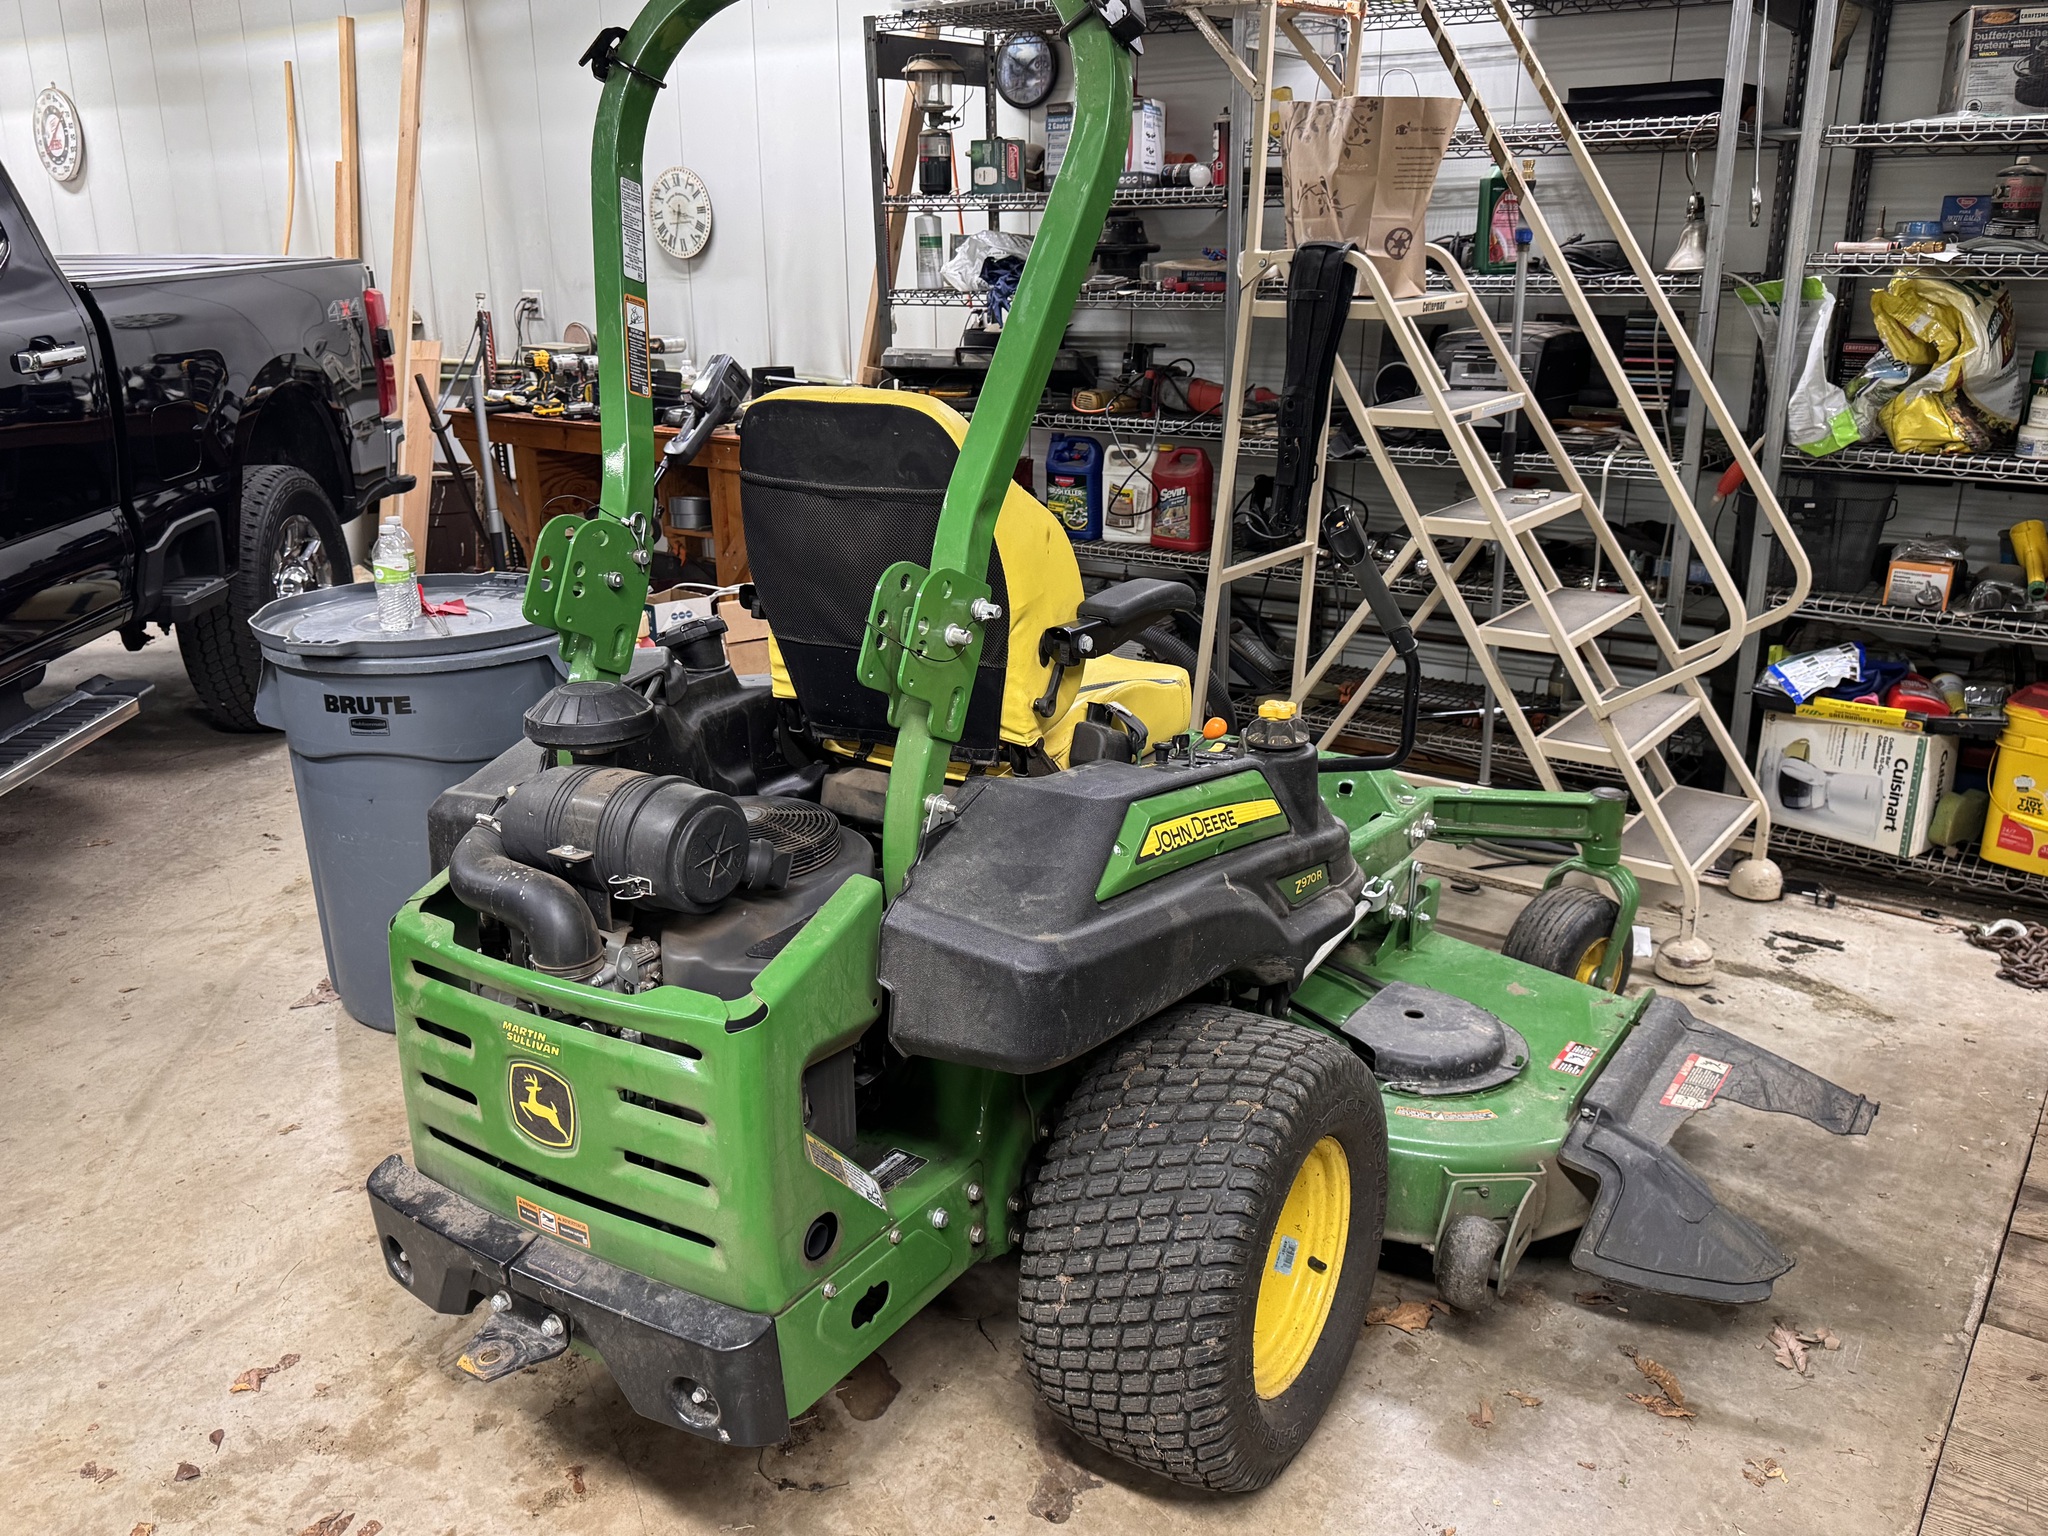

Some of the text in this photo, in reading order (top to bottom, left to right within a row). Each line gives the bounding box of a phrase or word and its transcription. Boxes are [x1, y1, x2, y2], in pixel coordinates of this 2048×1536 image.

[1973, 41, 2009, 52] system
[1160, 486, 1186, 502] Sevin
[323, 694, 414, 715] BRUTE
[1828, 712, 1870, 723] GREENHOUSE
[1932, 750, 1949, 804] Cuisin
[1884, 758, 1908, 833] Cuisinart
[2019, 797, 2044, 809] TIDY
[2017, 804, 2043, 816] CATS
[1155, 810, 1238, 852] JOHN DEERE
[1294, 869, 1323, 895] Z970R
[503, 1021, 546, 1042] MARTIN
[507, 1031, 560, 1056] SULLIVAN
